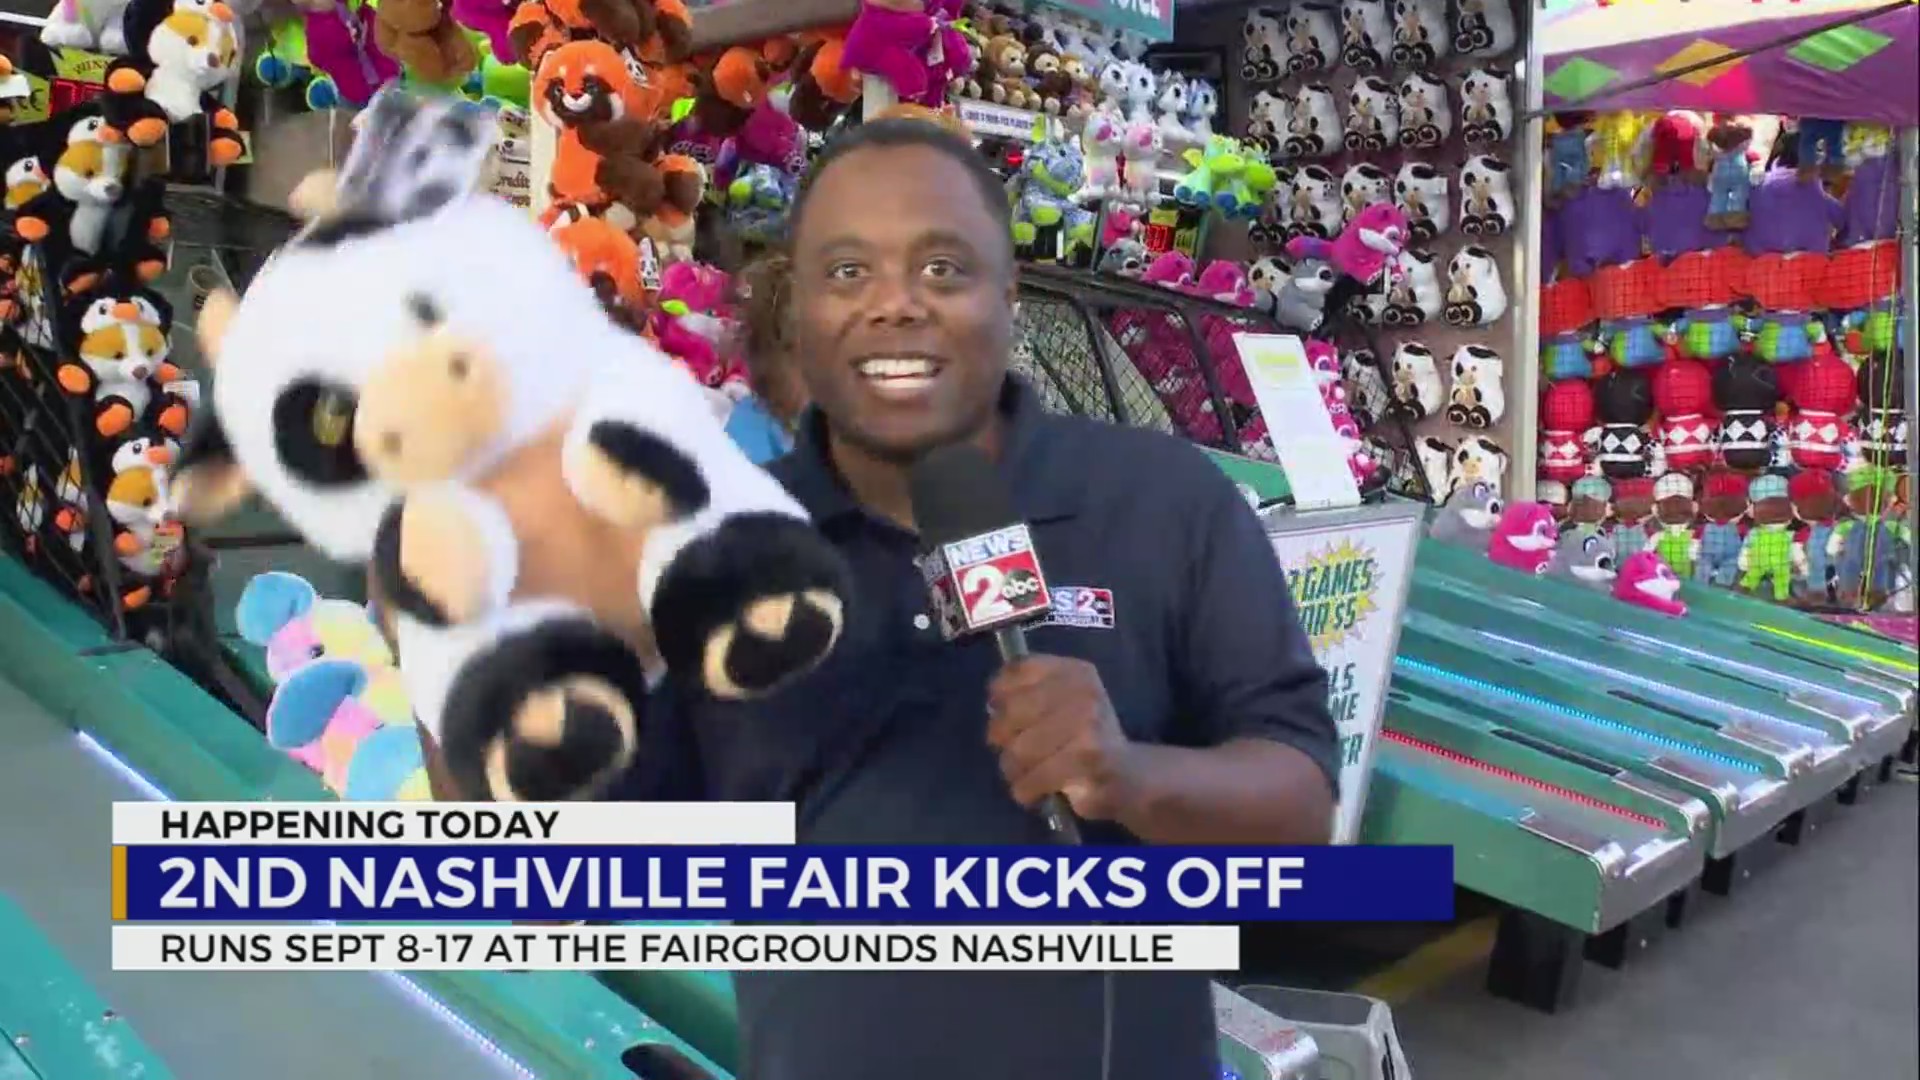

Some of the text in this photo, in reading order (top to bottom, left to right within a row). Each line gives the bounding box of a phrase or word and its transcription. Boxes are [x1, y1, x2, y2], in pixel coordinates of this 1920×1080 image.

[950, 534, 1025, 566] NEWS
[963, 564, 1014, 623] 2
[1001, 576, 1039, 600] abc
[1300, 559, 1374, 602] GAMES
[1299, 598, 1357, 636] OR $5
